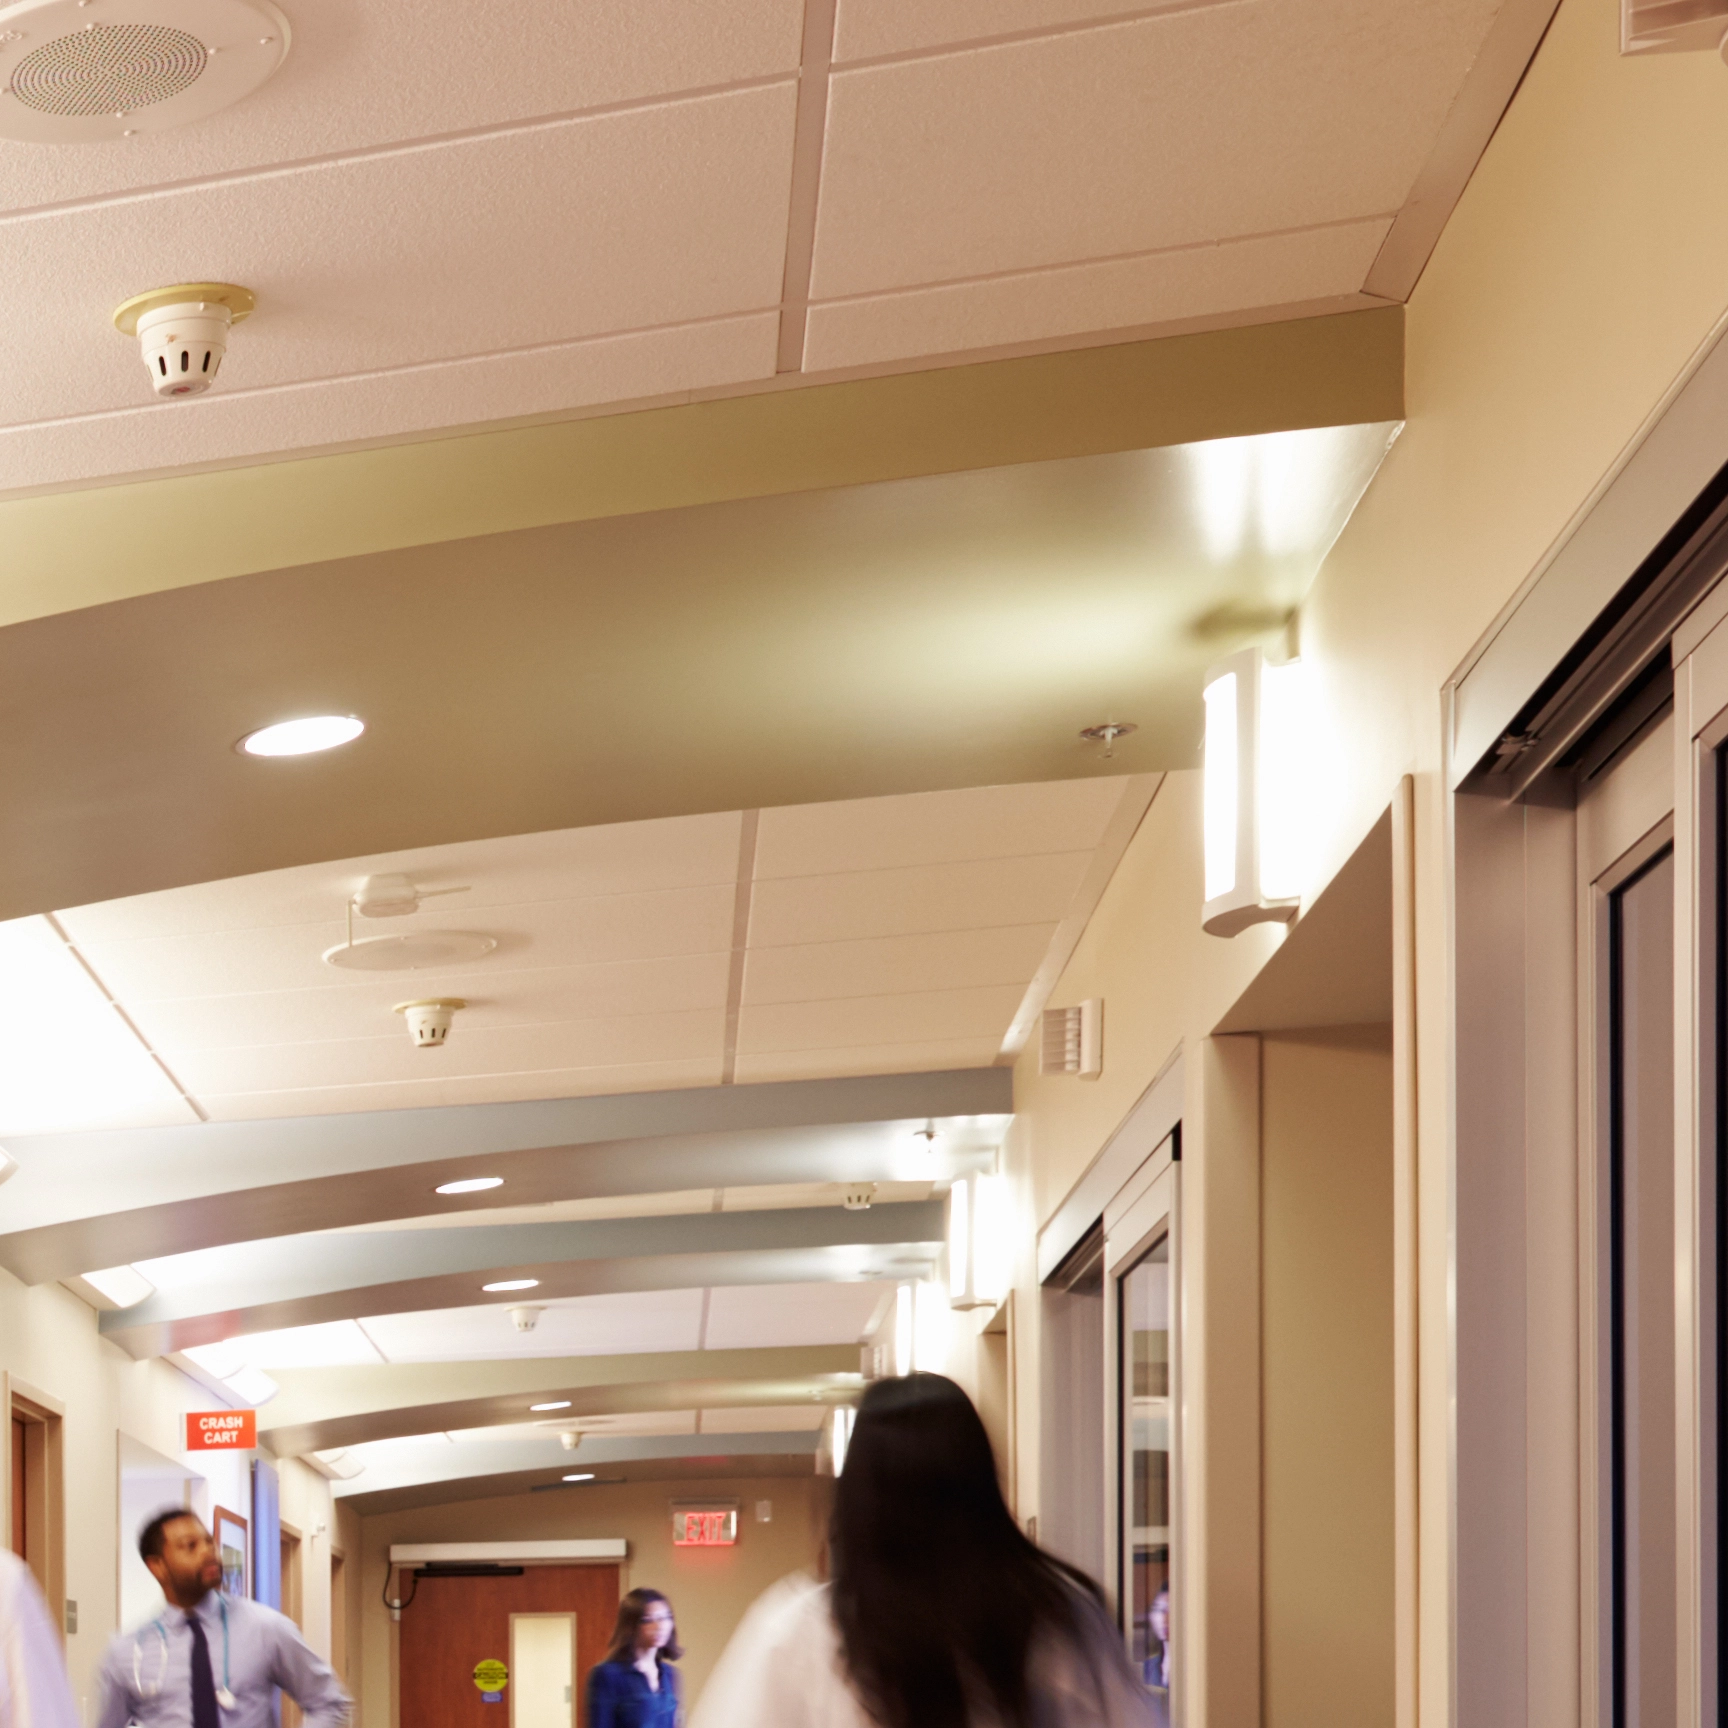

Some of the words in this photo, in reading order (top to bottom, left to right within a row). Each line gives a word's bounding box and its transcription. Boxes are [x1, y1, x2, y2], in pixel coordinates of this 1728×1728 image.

[199, 1416, 243, 1430] CRASH
[204, 1430, 238, 1444] CART
[686, 1513, 725, 1542] EXIT
